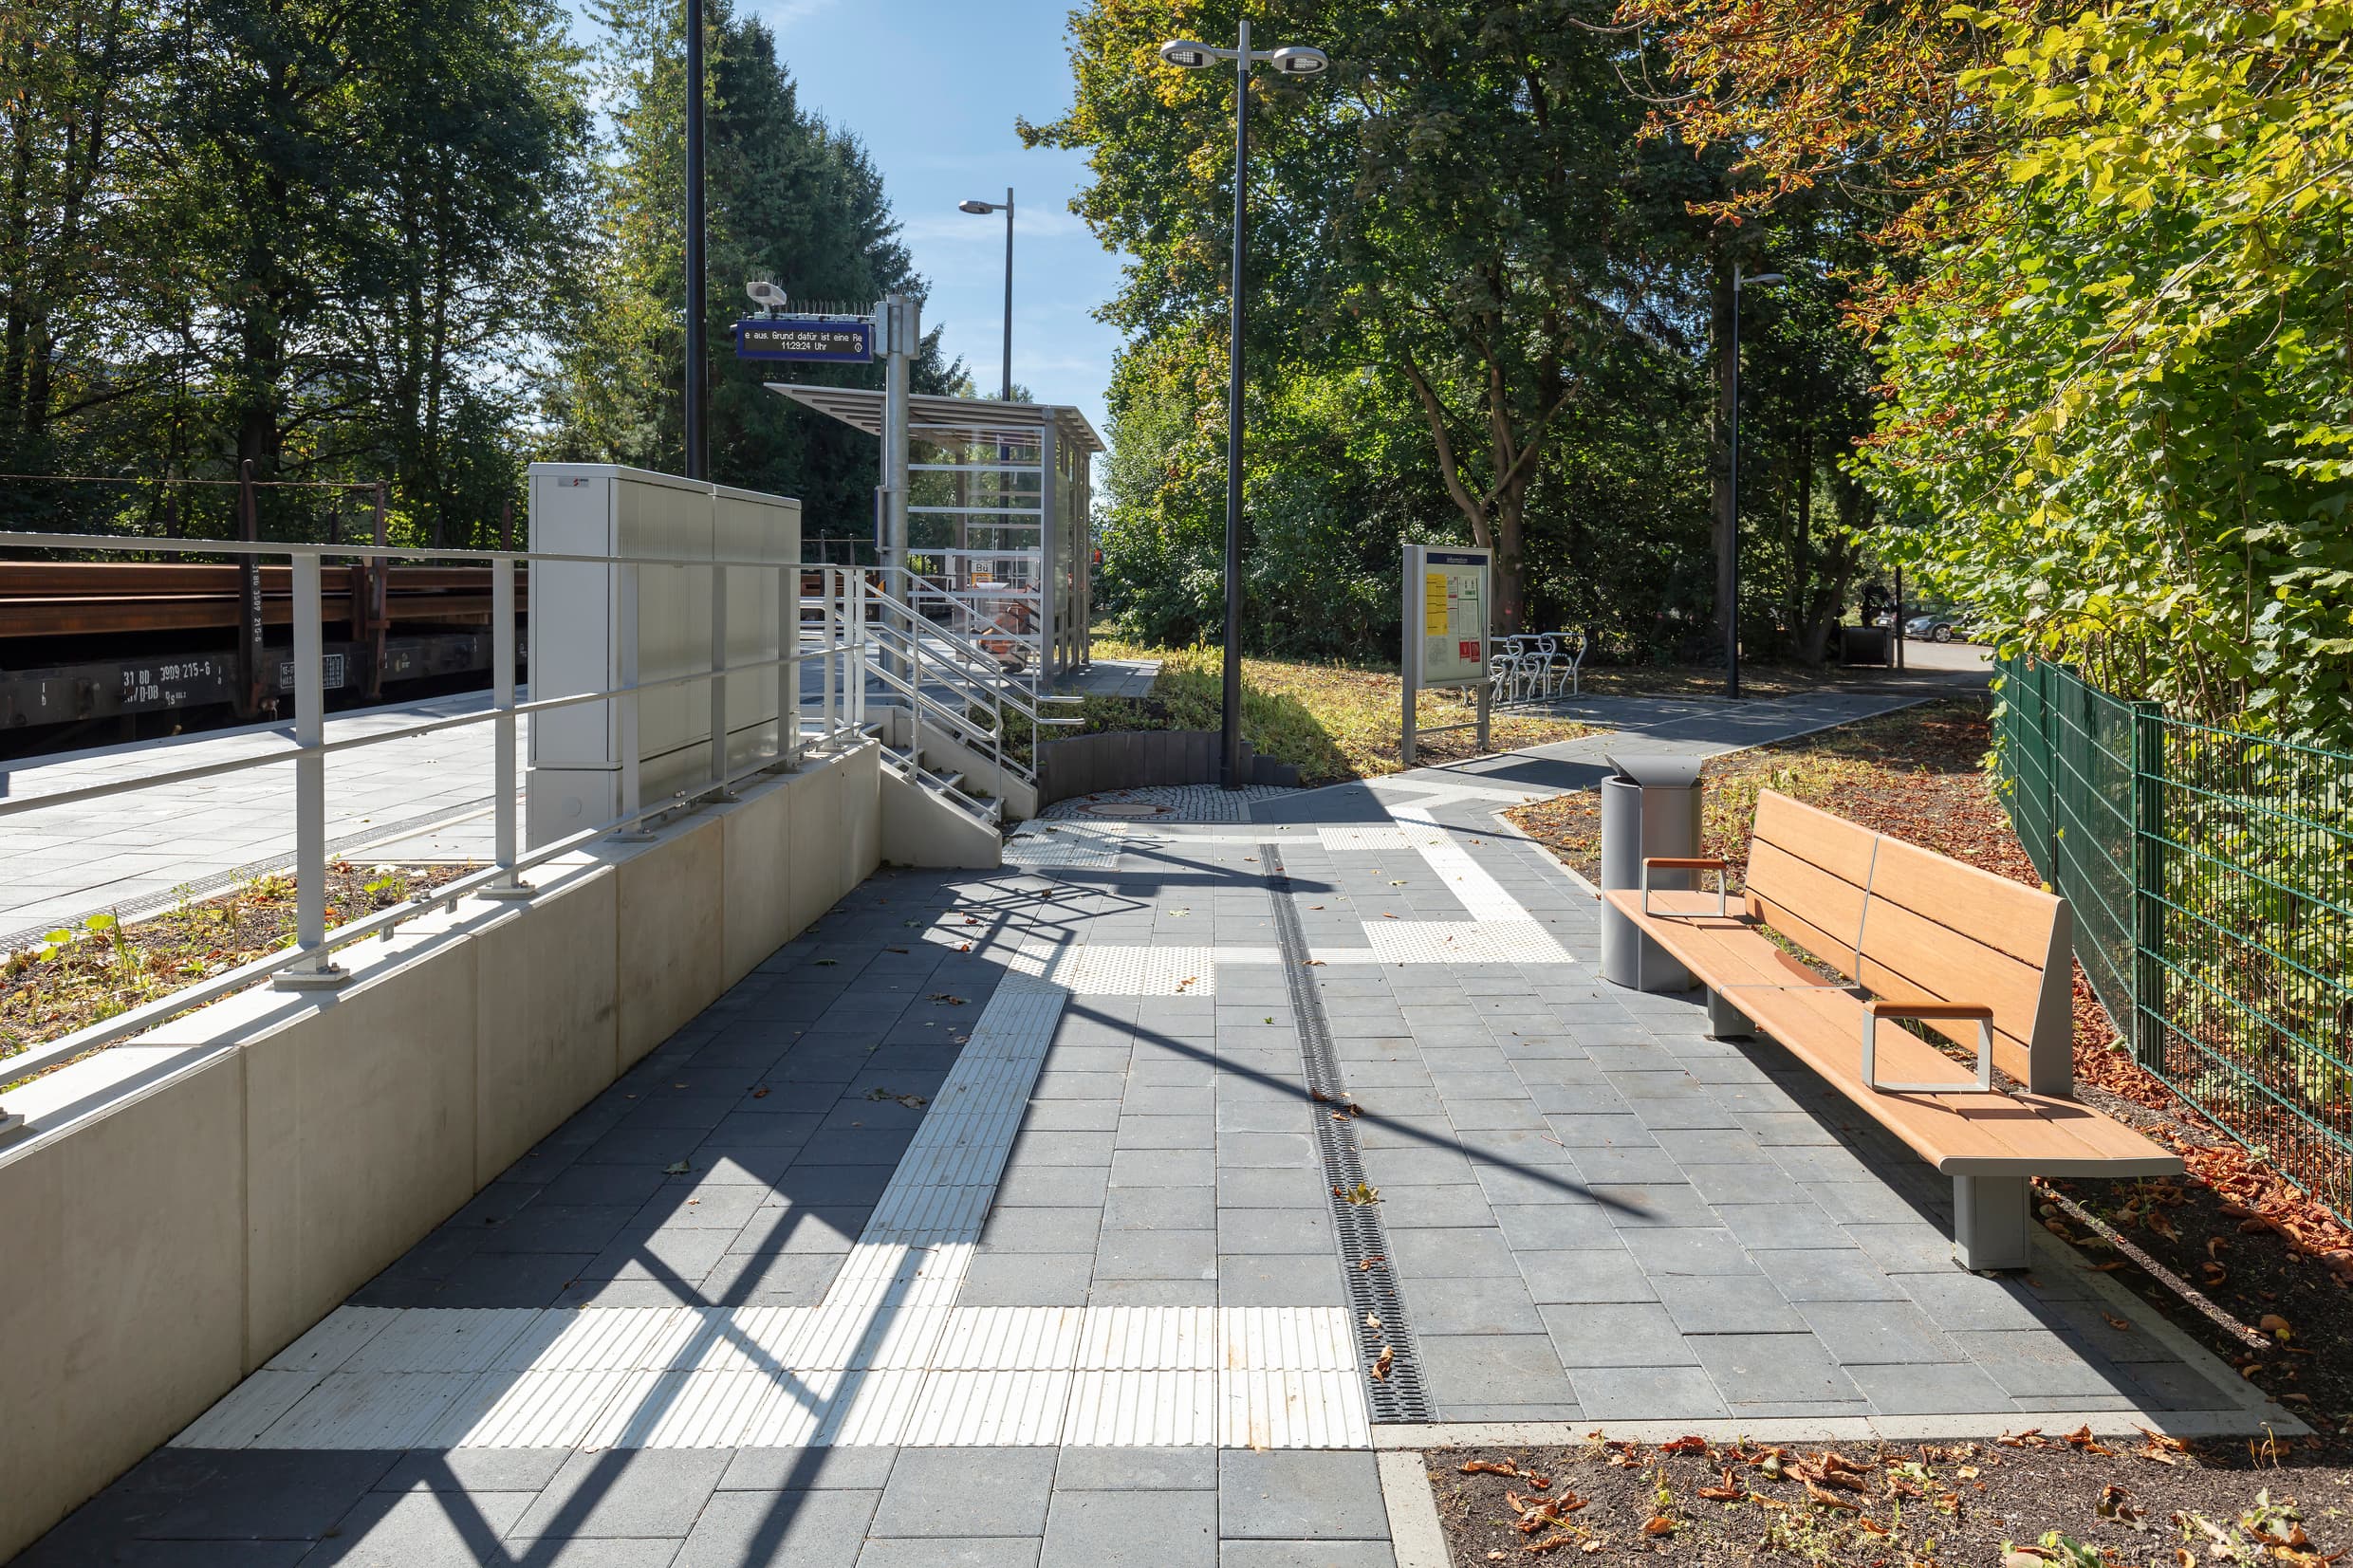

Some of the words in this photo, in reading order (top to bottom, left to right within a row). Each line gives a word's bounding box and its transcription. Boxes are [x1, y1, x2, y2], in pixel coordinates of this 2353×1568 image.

[772, 331, 794, 341] Grund
[797, 331, 817, 341] dafür
[821, 333, 830, 341] ist
[814, 342, 827, 351] Uhr
[123, 672, 134, 687] 31
[139, 670, 150, 685] 80
[159, 664, 180, 682] 3909
[182, 661, 211, 679] 215-6
